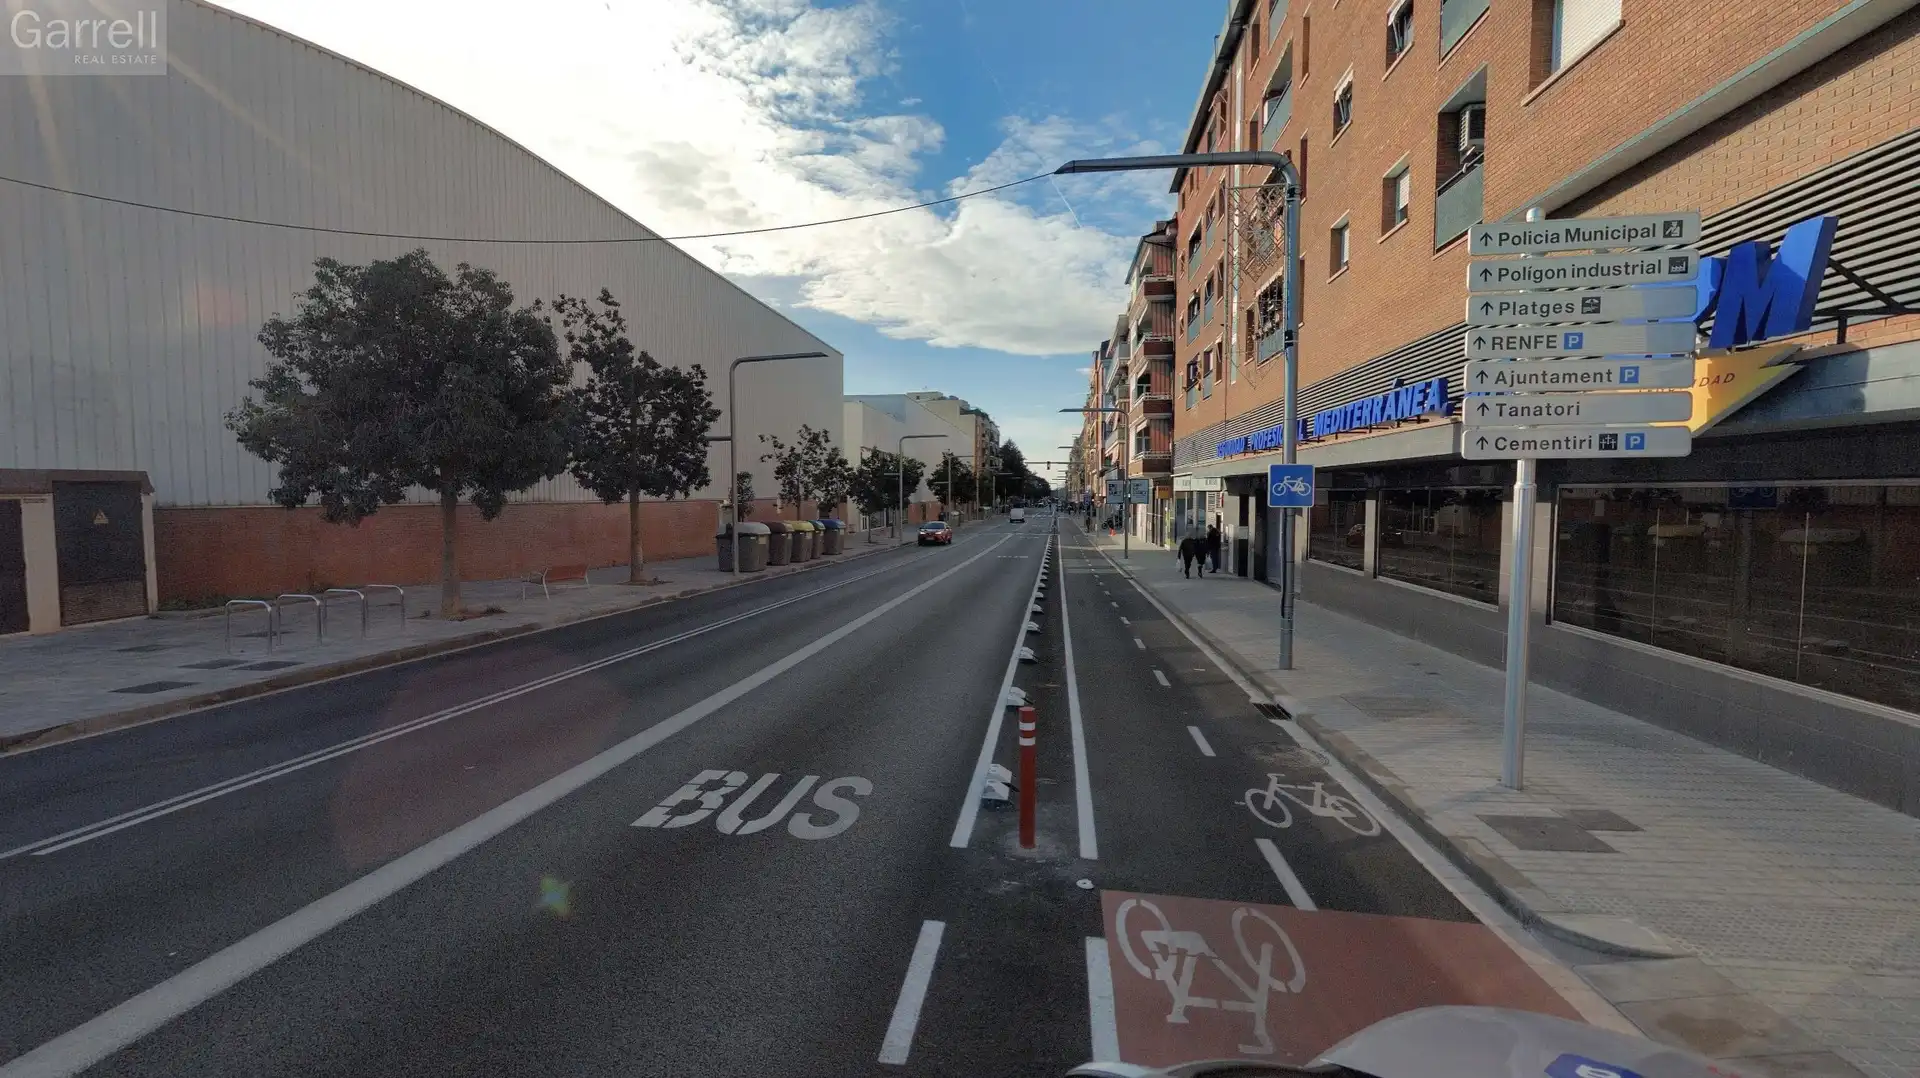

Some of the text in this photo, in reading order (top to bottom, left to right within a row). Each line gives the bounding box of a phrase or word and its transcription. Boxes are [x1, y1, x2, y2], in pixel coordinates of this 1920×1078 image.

[1564, 223, 1657, 243] Municipal
[1498, 259, 1662, 284] Polígon industrial
[1499, 300, 1575, 318] Platges
[1491, 335, 1558, 350] RENFE
[1494, 368, 1613, 387] Ajuntament
[1495, 402, 1580, 417] Tanatori
[1494, 435, 1593, 451] Cementiri
[630, 769, 873, 840] BUS
